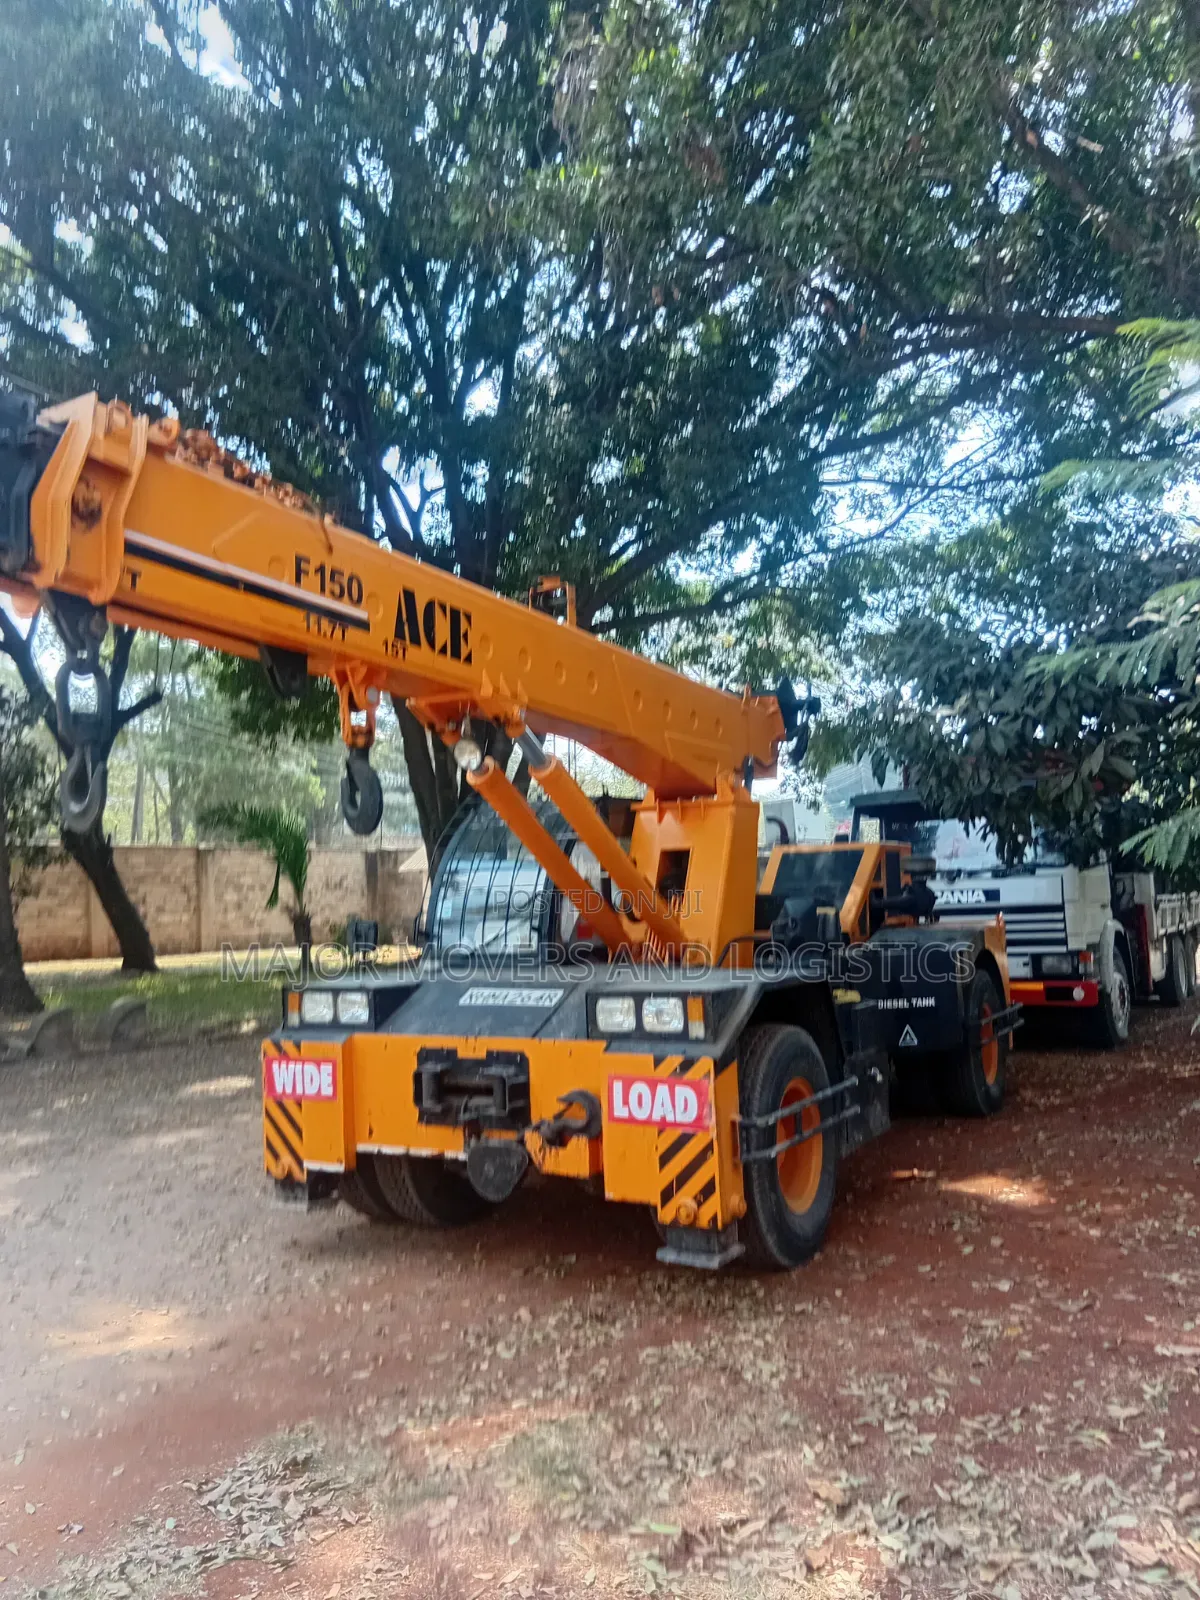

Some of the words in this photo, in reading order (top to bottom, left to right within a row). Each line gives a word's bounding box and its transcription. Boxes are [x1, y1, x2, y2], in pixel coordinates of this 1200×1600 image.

[294, 553, 363, 605] F150
[394, 585, 473, 666] ACE
[878, 998, 910, 1010] DIESEL
[911, 996, 936, 1008] TANK
[272, 1060, 333, 1096] WIDE
[613, 1080, 698, 1124] LOAD
